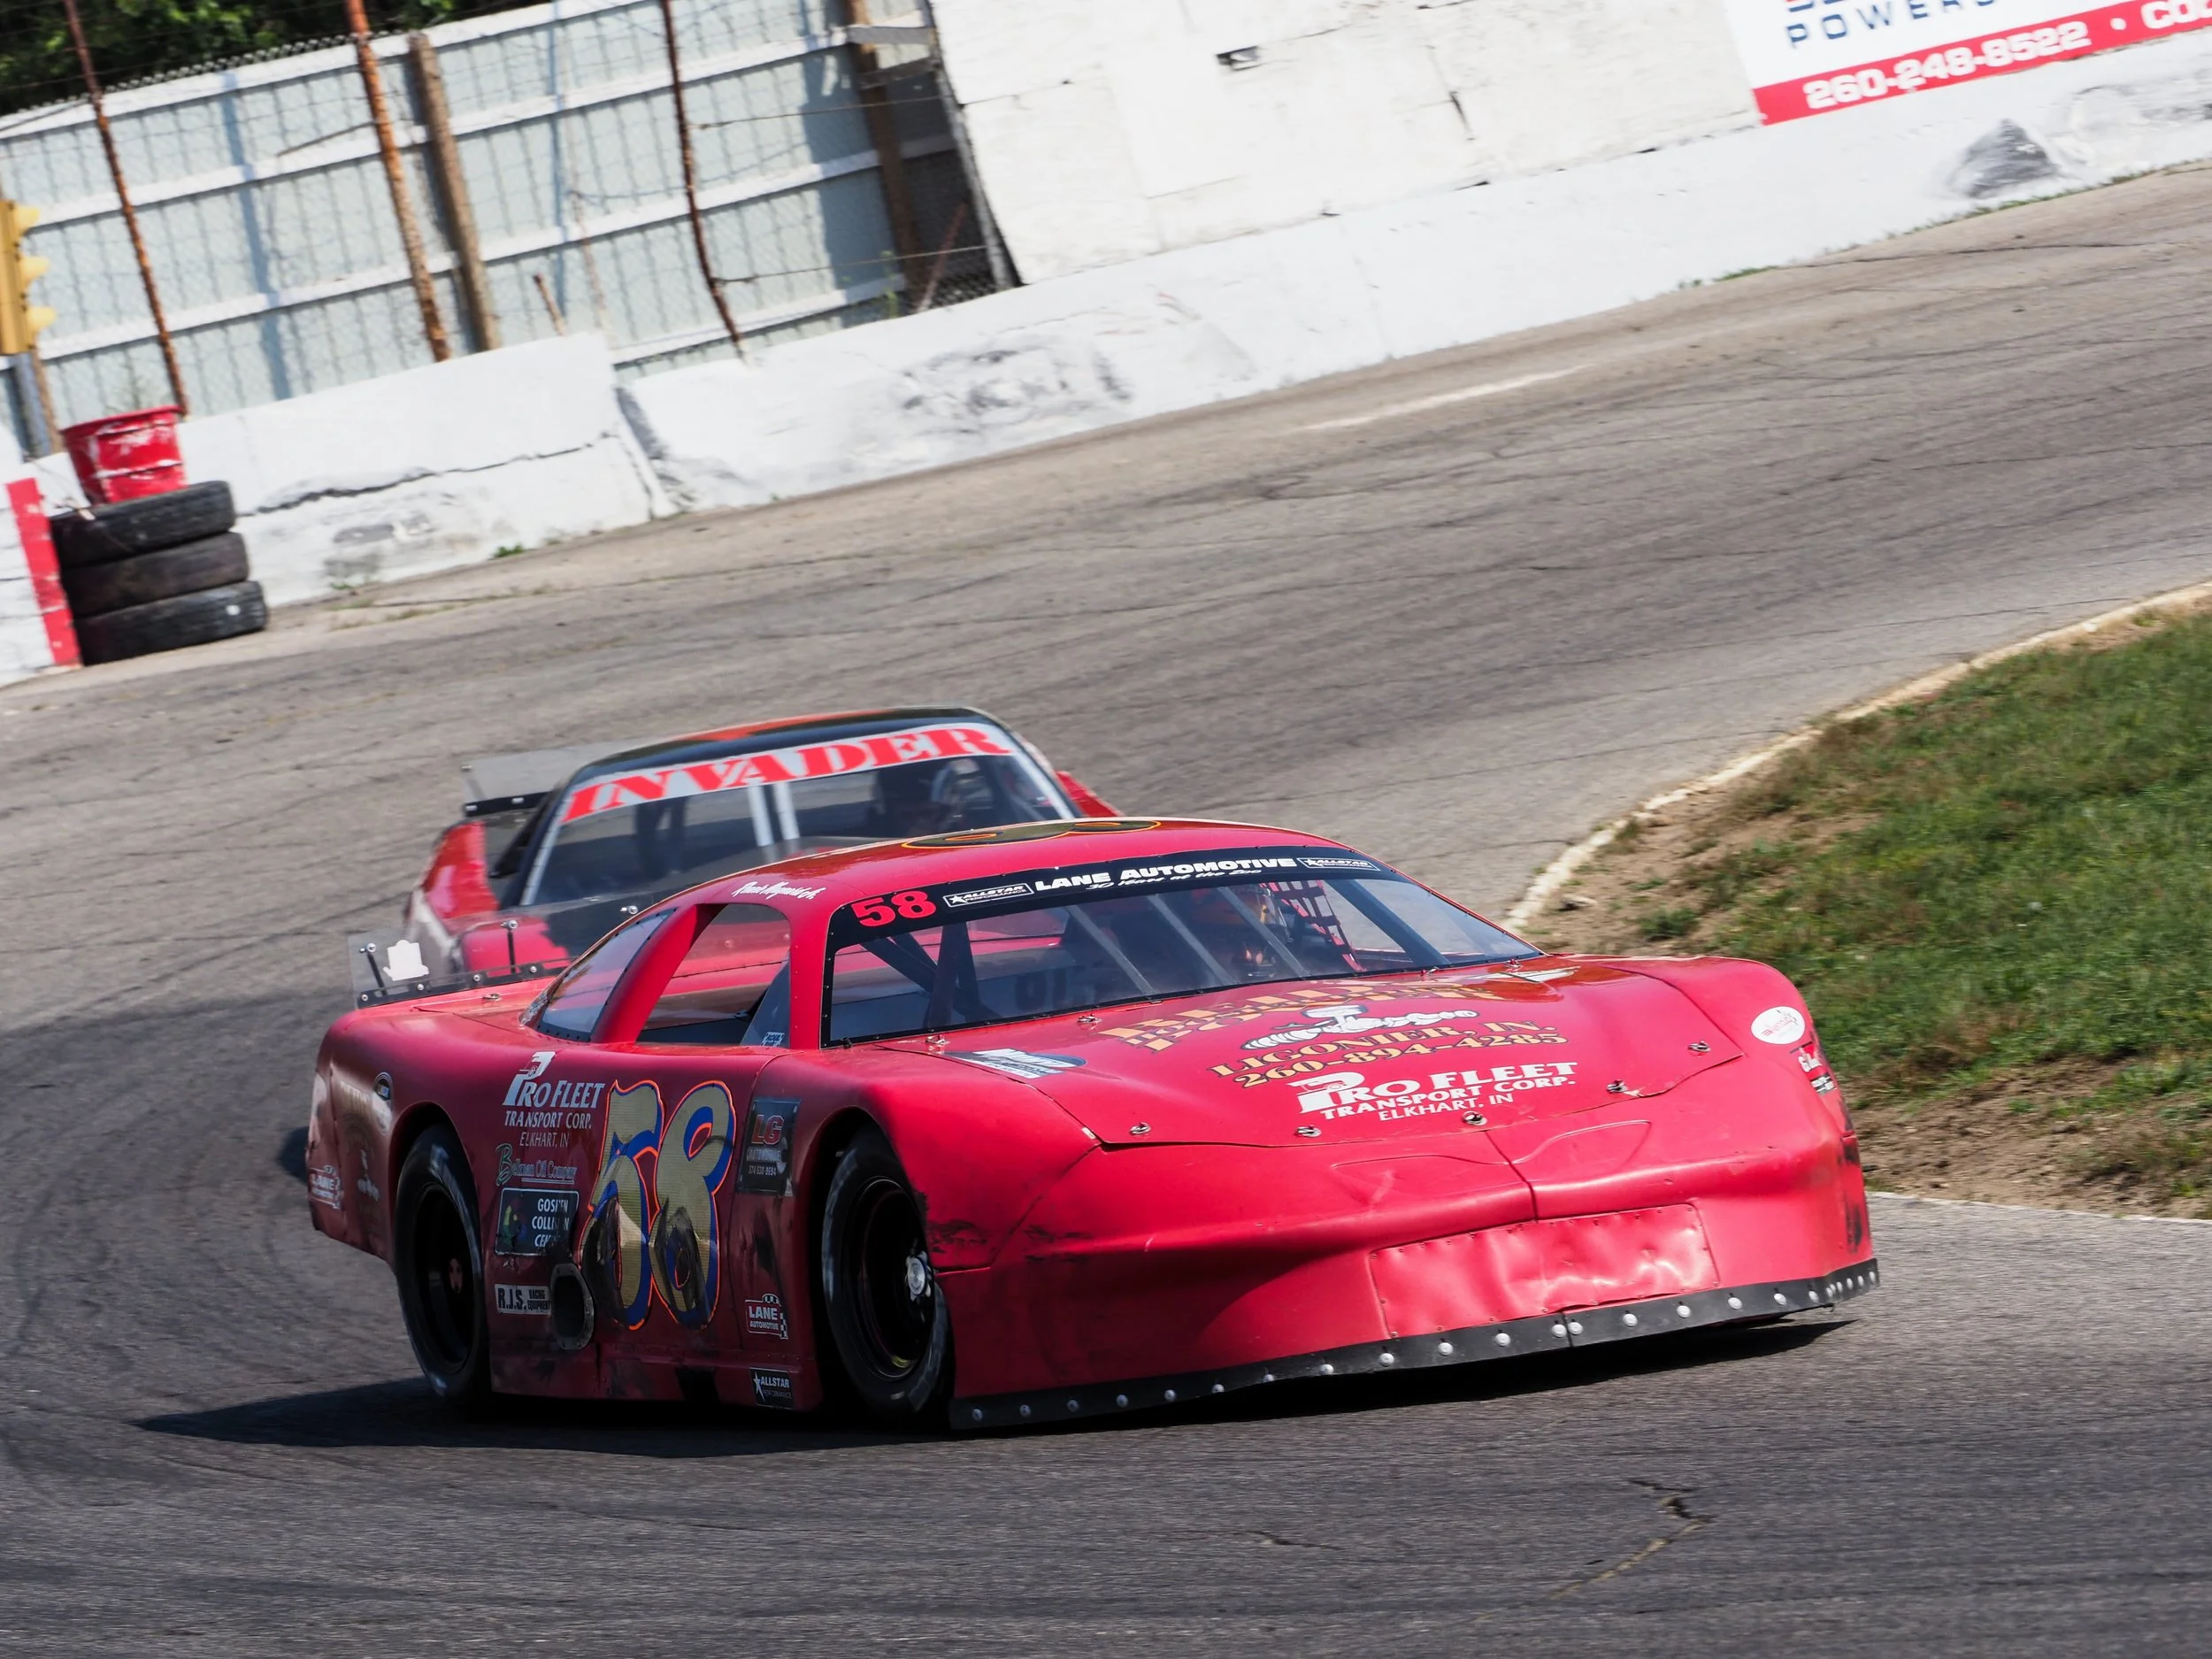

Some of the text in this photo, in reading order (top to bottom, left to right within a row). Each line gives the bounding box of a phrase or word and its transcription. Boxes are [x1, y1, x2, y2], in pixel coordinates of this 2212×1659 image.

[1802, 21, 2093, 109] 260-248-8522
[563, 726, 1014, 824] INVADER
[1034, 857, 1298, 891] LANE AUTOMOTIVE
[850, 890, 937, 927] 58
[963, 885, 1025, 899] ALLSTAR
[1209, 1020, 1558, 1078] LIGONIER, IN.
[1233, 1033, 1569, 1088] 260-894-4285
[503, 1051, 606, 1109] PRO FLEET
[1286, 1062, 1578, 1114] PRO FLEET
[1321, 1076, 1577, 1120] TRANSPORT CORP.
[1488, 1093, 1515, 1105] IN
[504, 1110, 592, 1129] TRANSPORT CORP.
[751, 1114, 786, 1145] LG
[559, 1133, 571, 1148] IN
[579, 1079, 737, 1331] 58
[497, 1287, 527, 1310] R.J.S.
[749, 1305, 779, 1321] LANE
[749, 1320, 780, 1331] AUTOMOTIVE
[760, 1376, 790, 1389] ALLSTAR
